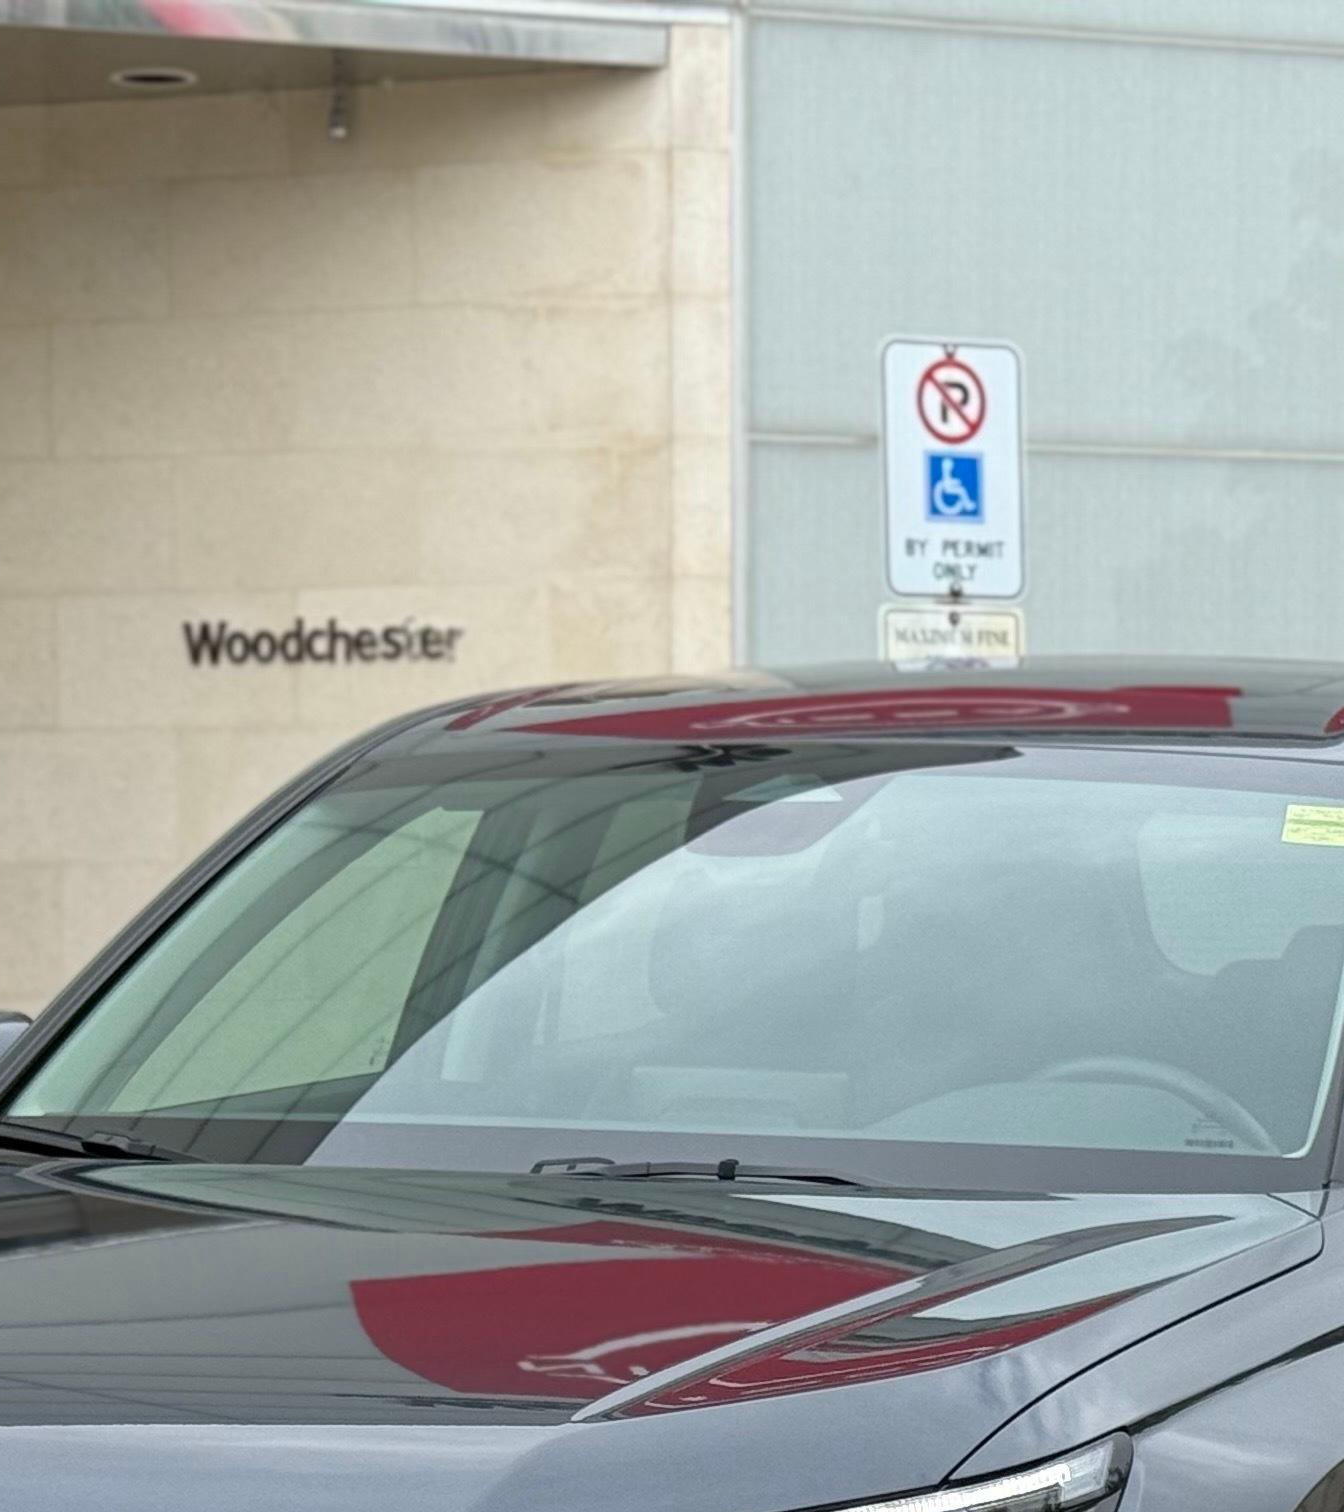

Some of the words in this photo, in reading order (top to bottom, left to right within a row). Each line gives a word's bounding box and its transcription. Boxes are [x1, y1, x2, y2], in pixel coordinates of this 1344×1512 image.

[904, 537, 927, 557] BY
[943, 538, 1005, 558] PERMIT
[933, 562, 977, 581] ONLY
[182, 616, 464, 667] Woodchester
